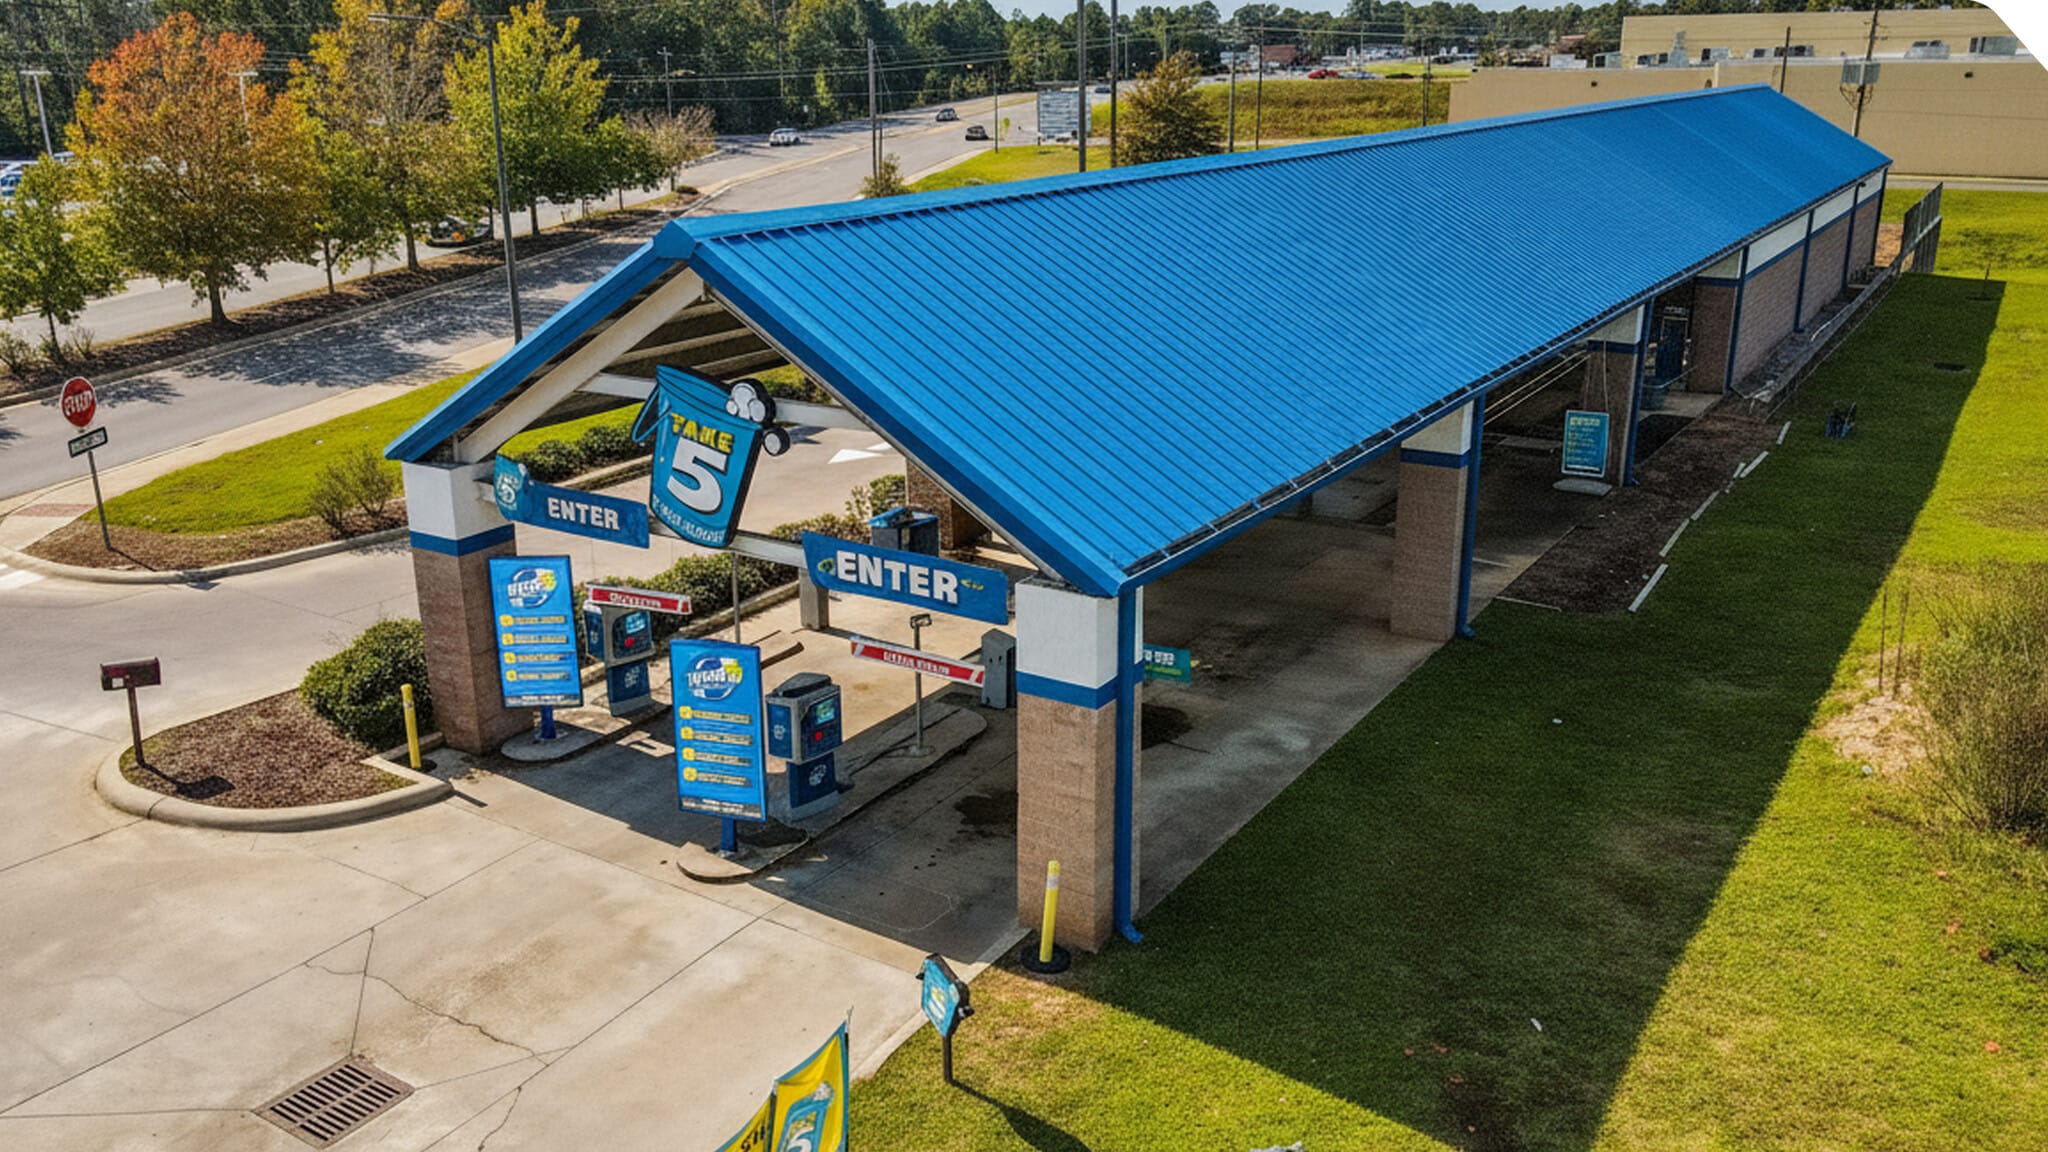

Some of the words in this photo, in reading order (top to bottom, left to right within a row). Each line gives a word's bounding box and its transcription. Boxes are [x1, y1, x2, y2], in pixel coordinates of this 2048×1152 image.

[671, 413, 734, 454] TAKE
[667, 437, 728, 513] 5
[547, 497, 620, 530] ENTER
[835, 550, 958, 604] ENTER
